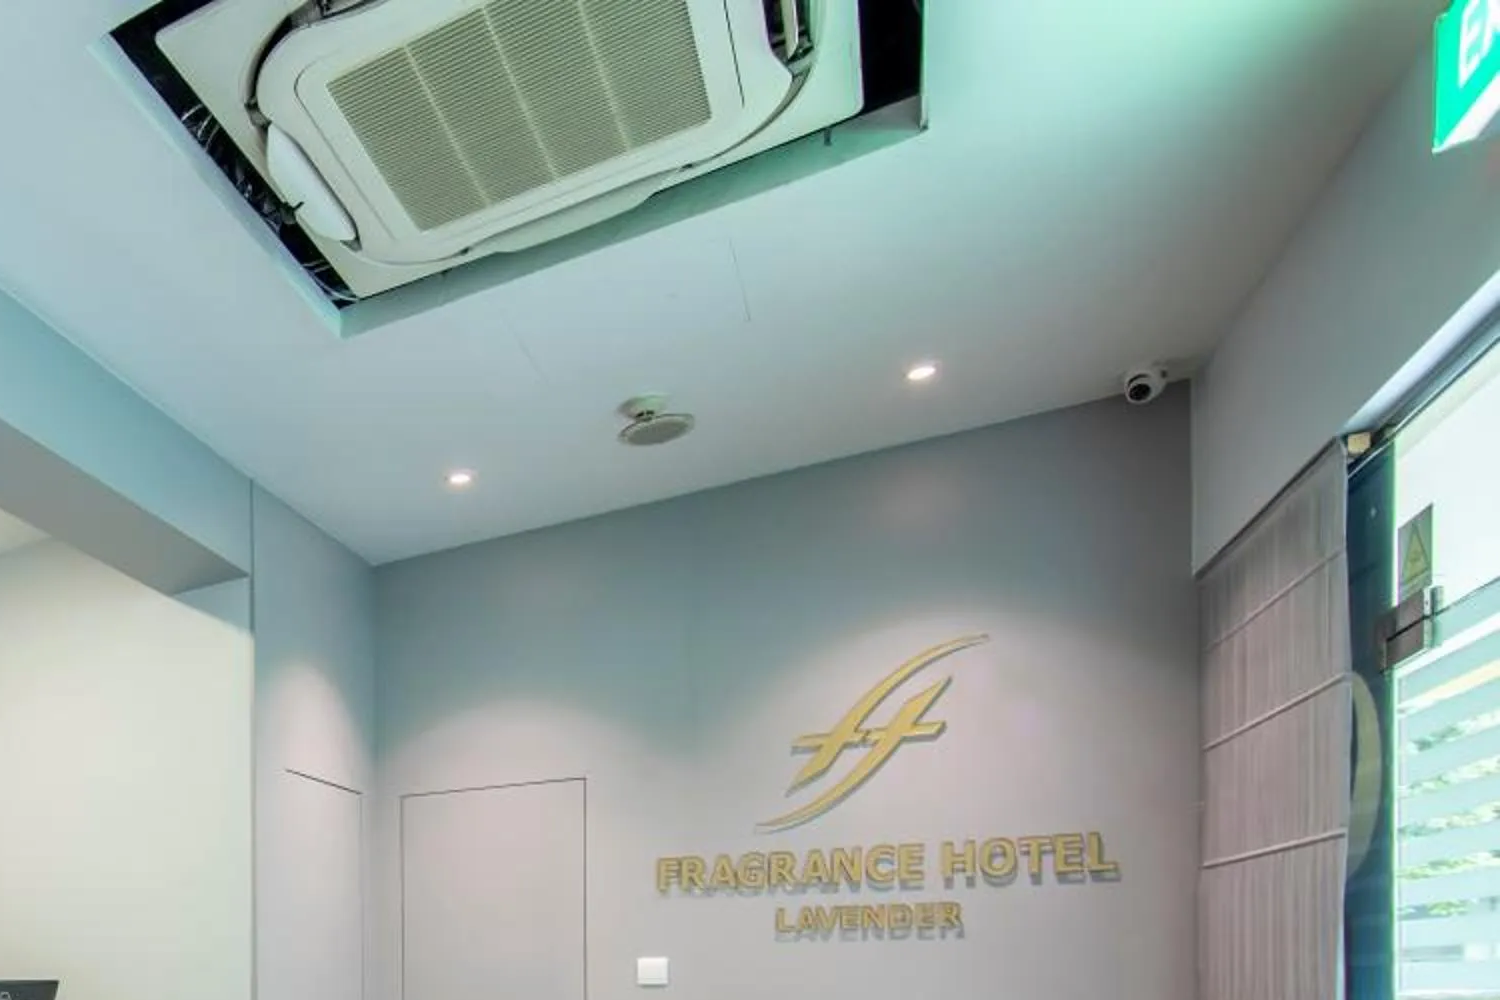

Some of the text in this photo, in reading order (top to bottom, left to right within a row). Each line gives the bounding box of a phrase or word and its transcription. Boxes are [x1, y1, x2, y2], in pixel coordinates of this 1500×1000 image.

[655, 832, 1119, 893] FRAGRANCE HOTEL
[774, 901, 963, 934] LAVENDER
